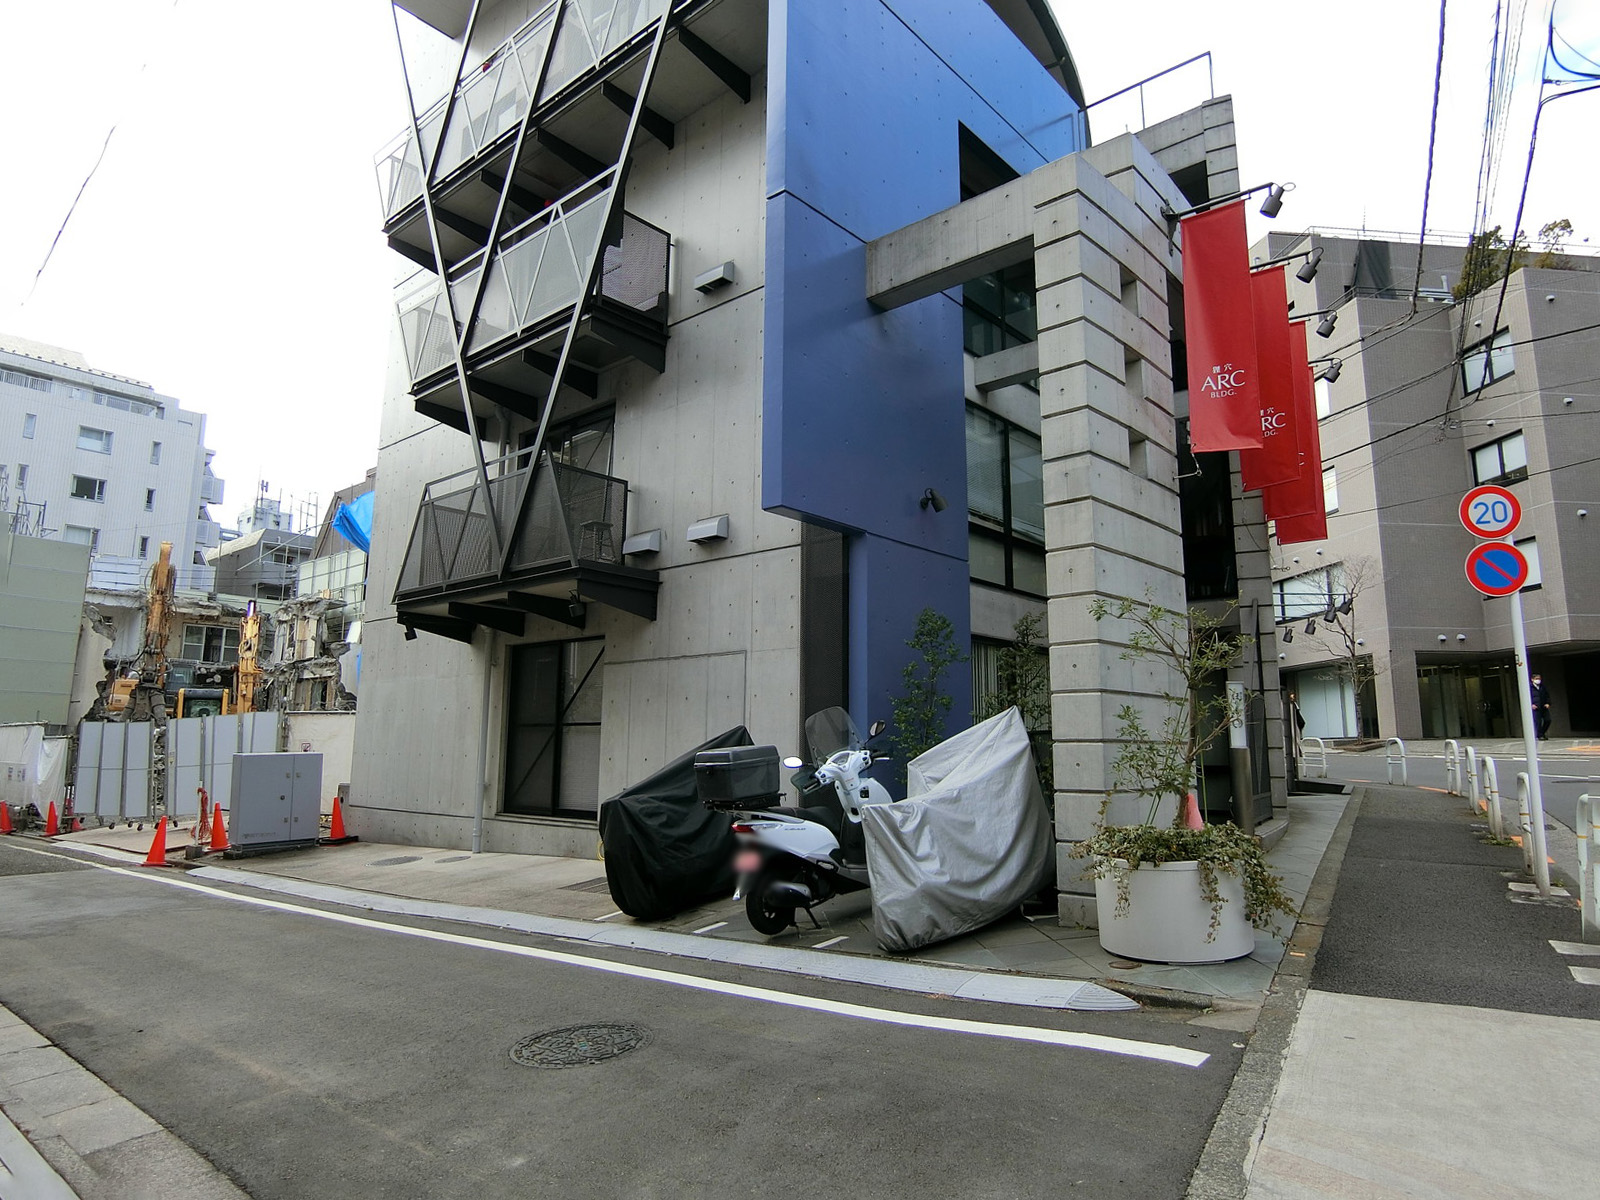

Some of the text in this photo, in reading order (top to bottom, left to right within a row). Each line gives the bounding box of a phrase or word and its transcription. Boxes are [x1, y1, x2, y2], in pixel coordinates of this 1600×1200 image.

[1201, 369, 1246, 392] ARC
[1210, 388, 1237, 399] BLDG.
[1260, 412, 1287, 431] RC
[1261, 429, 1279, 438] DG.
[1473, 500, 1508, 525] 20
